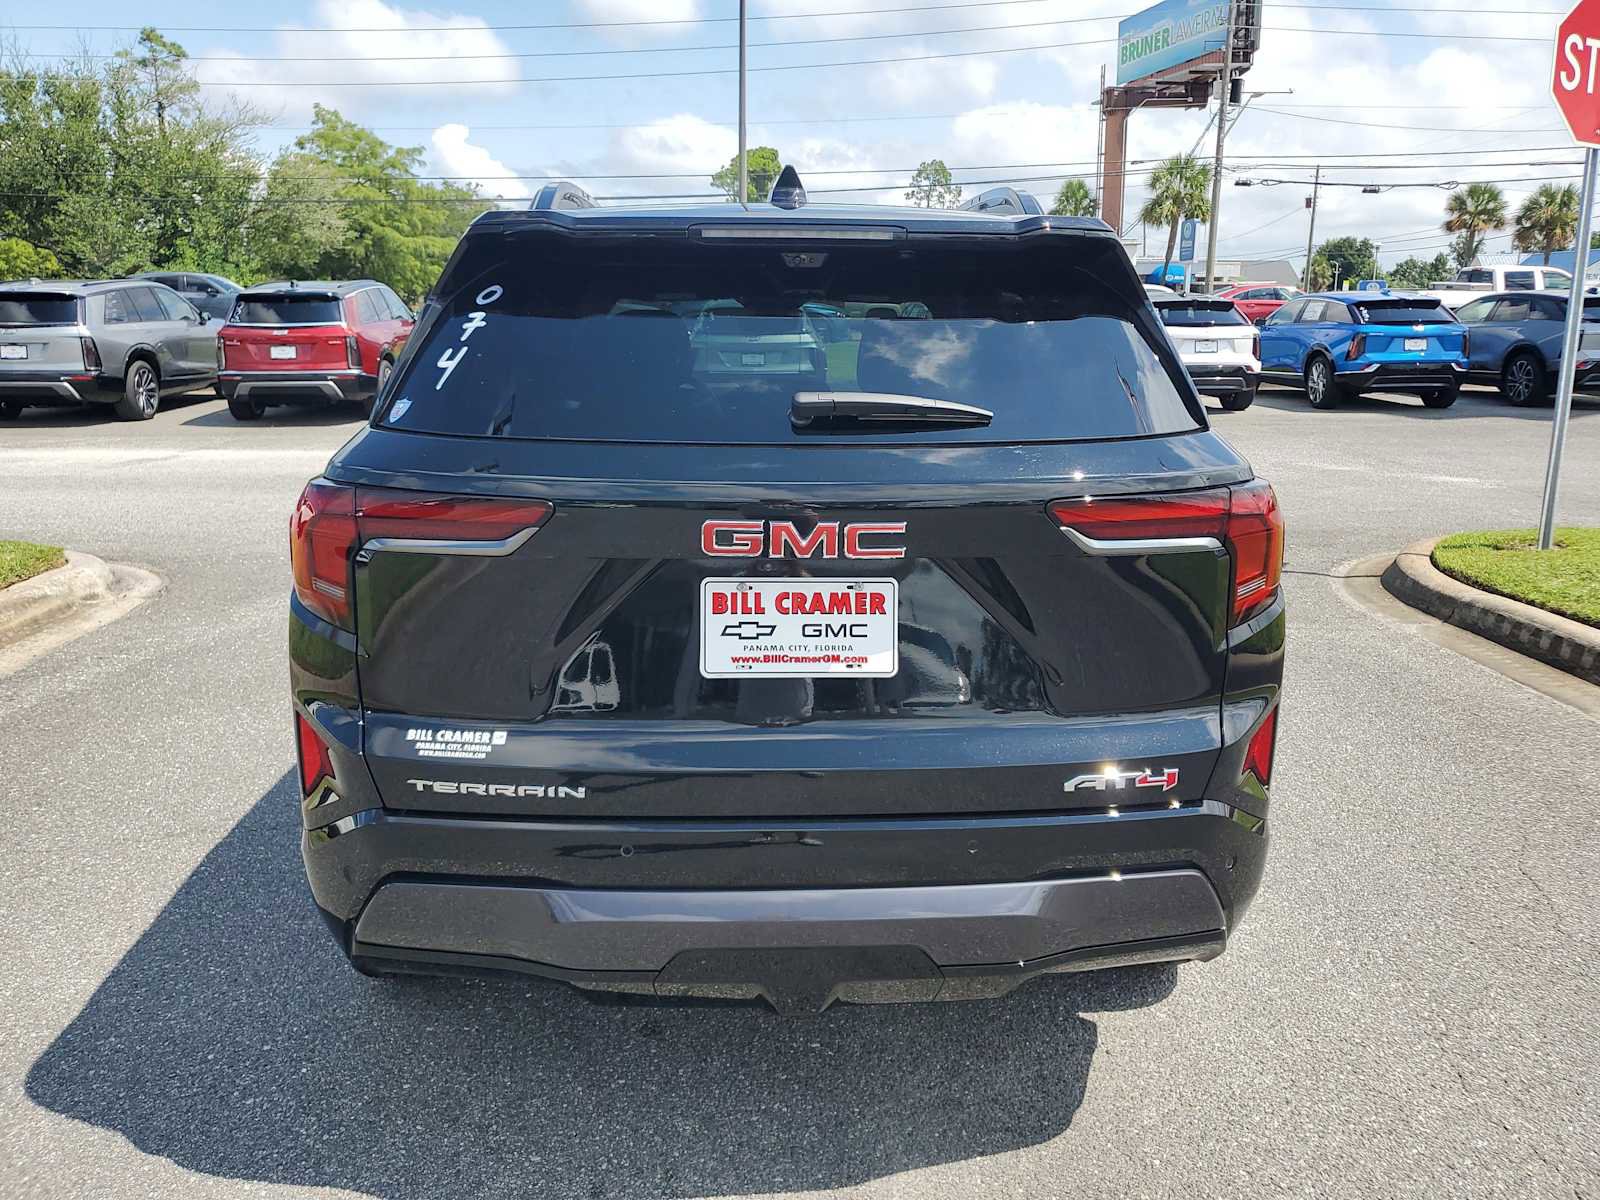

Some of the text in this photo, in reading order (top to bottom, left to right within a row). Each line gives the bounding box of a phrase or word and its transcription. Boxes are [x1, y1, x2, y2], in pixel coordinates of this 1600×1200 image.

[1120, 27, 1170, 65] BRUNER
[701, 519, 907, 559] GMC
[712, 591, 887, 615] BILL CRAMER
[802, 623, 868, 638] GMC
[743, 644, 854, 653] PANAMA CITY, FLORIDA
[731, 654, 868, 664] www.BillCramerGM.com
[405, 729, 491, 743] BILL CRAMER
[407, 779, 586, 799] TERRAIN
[1063, 767, 1179, 792] AT4
